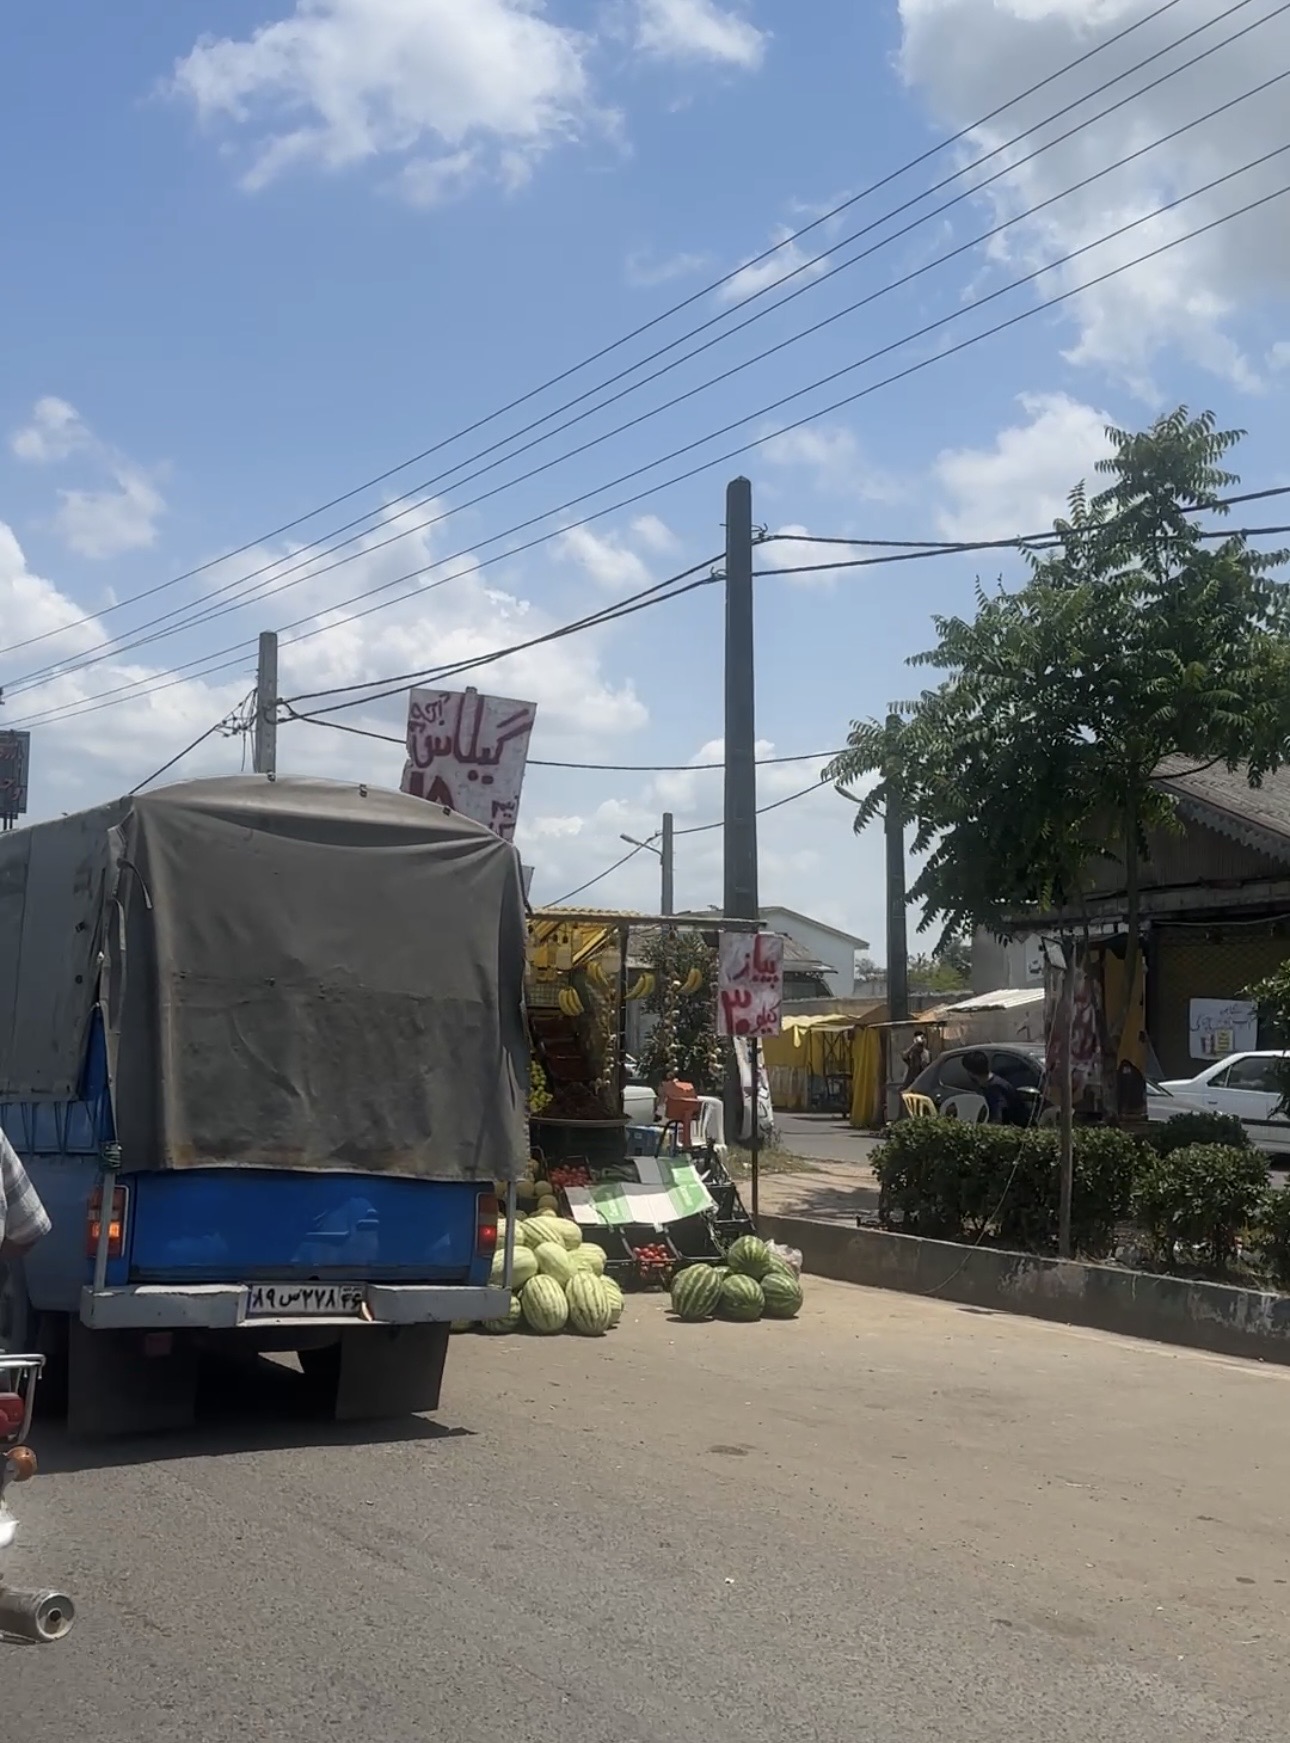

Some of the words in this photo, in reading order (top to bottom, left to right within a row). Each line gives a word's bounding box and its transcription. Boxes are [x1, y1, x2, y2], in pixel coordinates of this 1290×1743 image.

[412, 694, 533, 785] گیلاس
[731, 934, 780, 990] پیاز
[750, 1000, 782, 1035] کیلو
